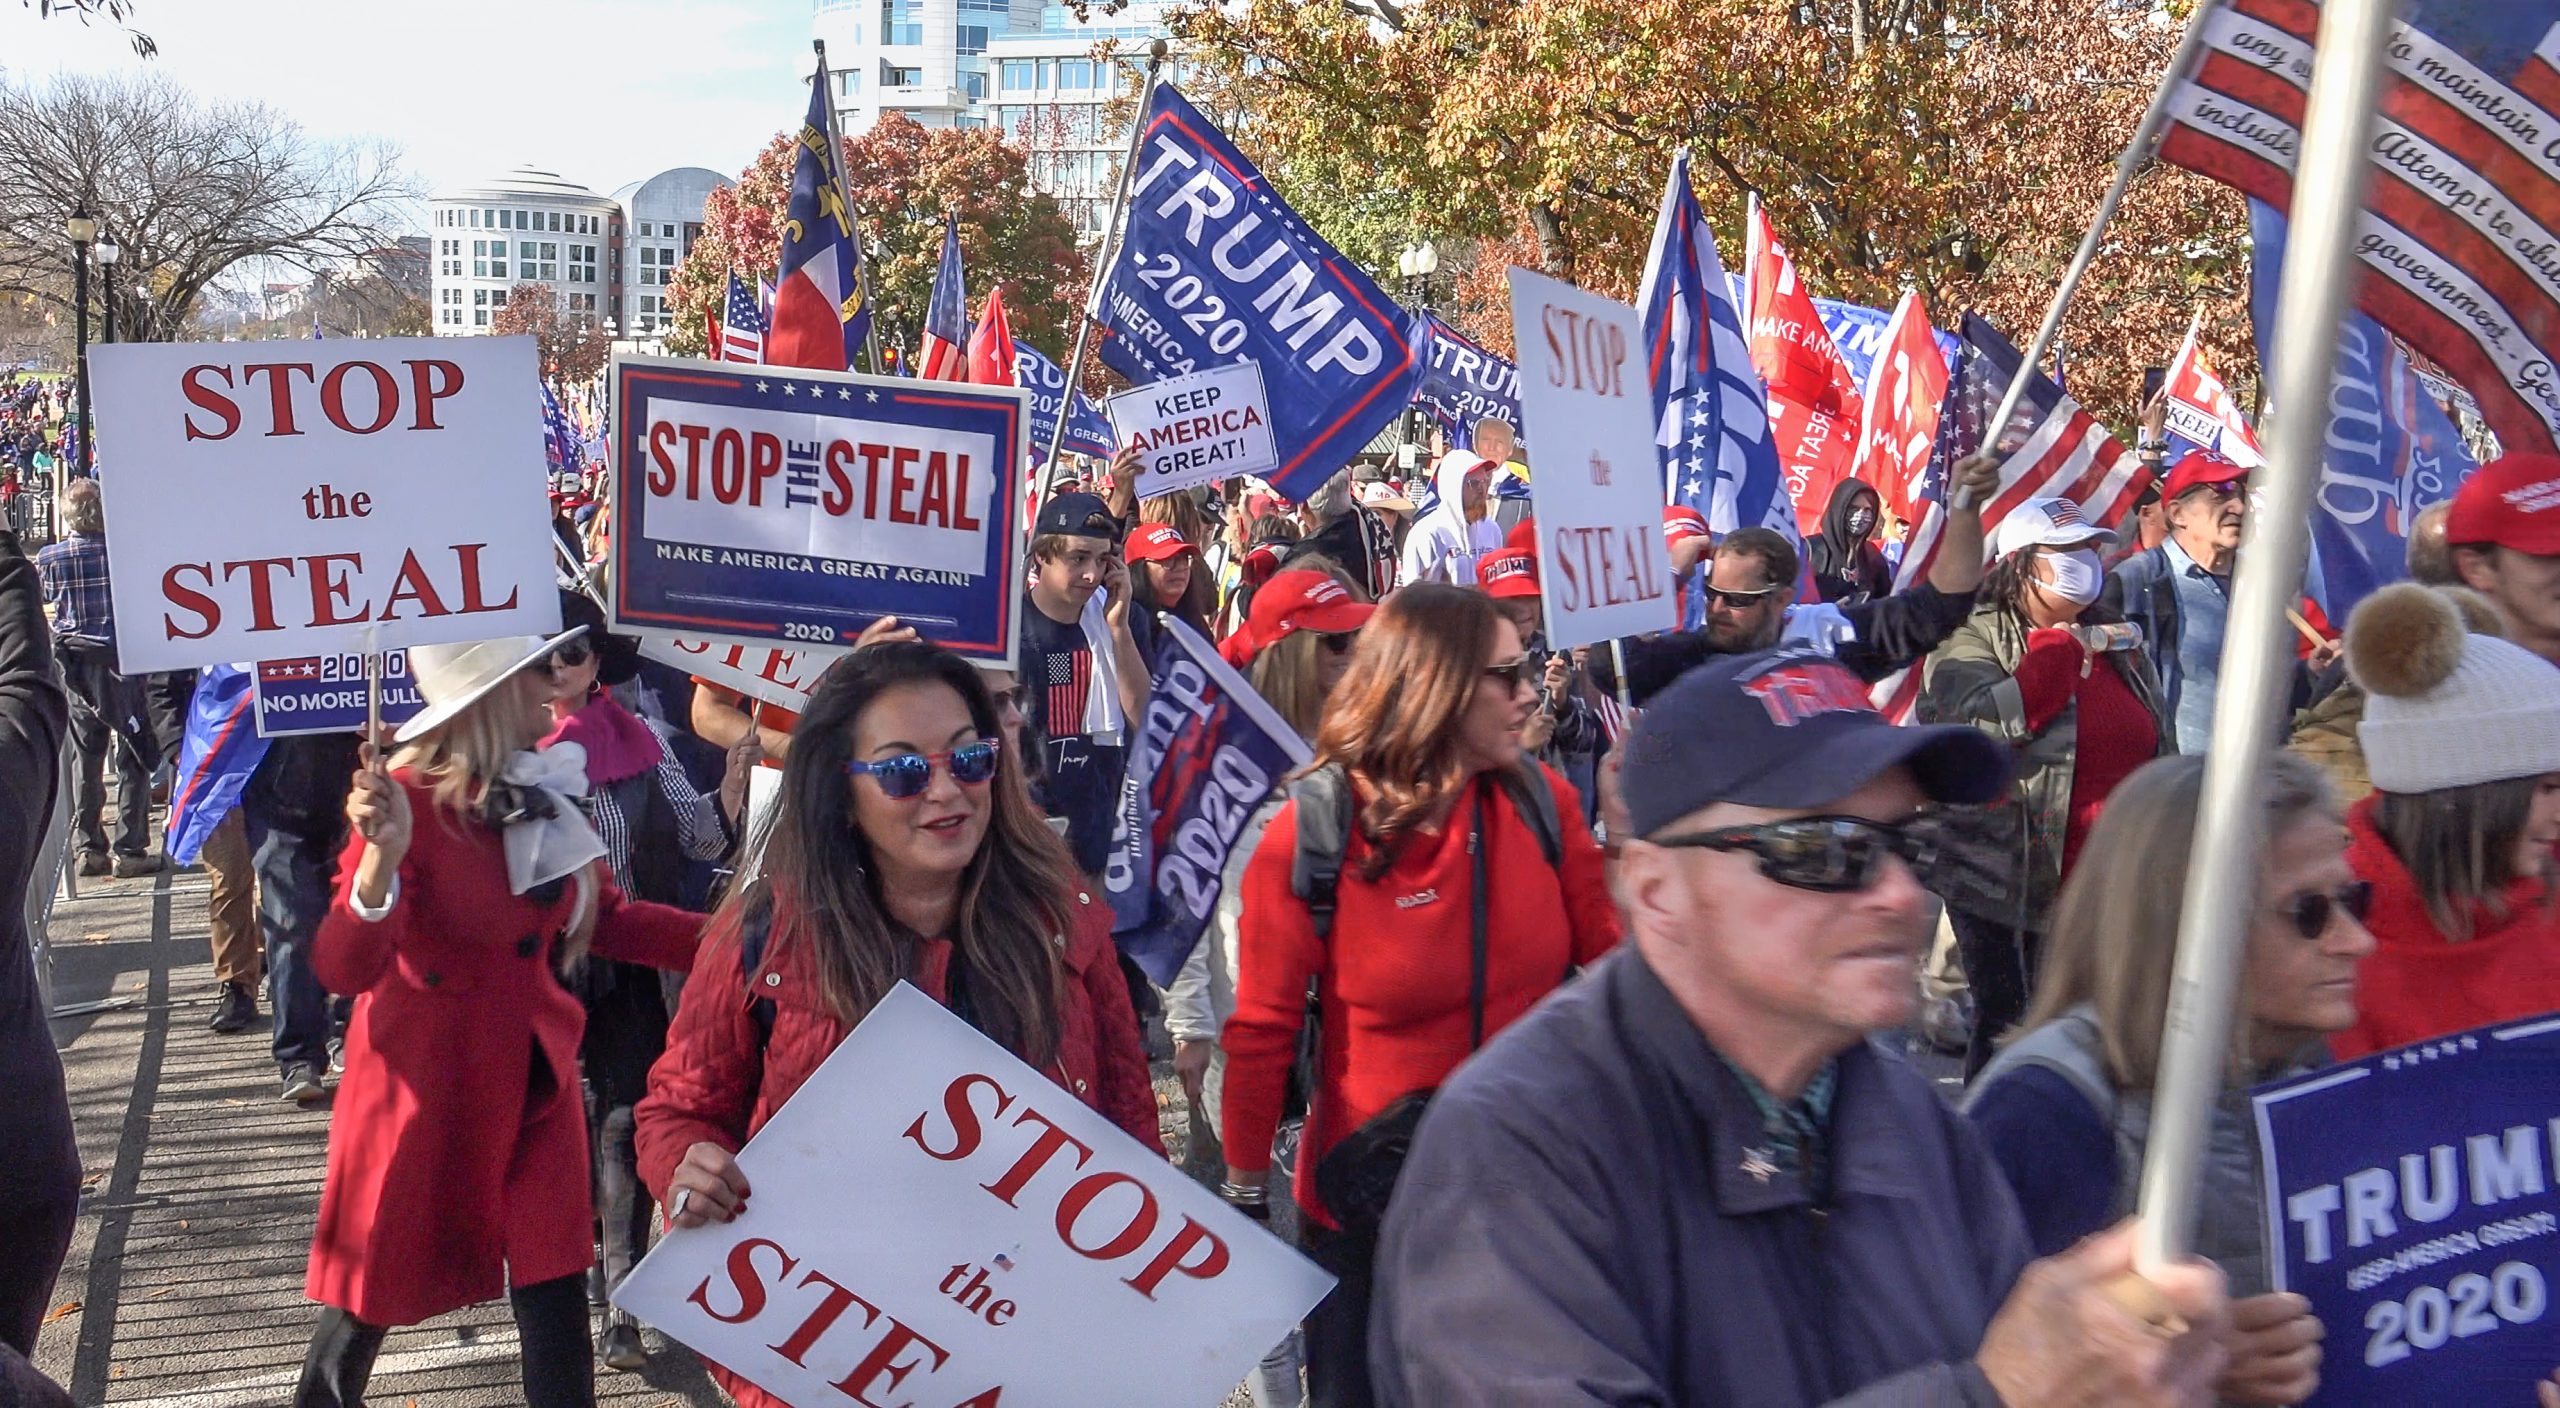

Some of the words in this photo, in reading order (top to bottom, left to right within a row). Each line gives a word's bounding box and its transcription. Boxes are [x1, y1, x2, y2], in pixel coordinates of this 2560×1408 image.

[2232, 32, 2288, 68] any
[2415, 57, 2540, 145] maintain
[2371, 131, 2493, 216] Attempt
[2488, 209, 2514, 239] to
[1132, 133, 1384, 376] TRUMP
[1542, 303, 1627, 396] STOP
[1753, 317, 1802, 343] MAKE
[181, 360, 465, 441] STOP
[1131, 405, 1262, 454] AMERICA
[1155, 386, 1221, 418] KEEP
[648, 420, 782, 507] STOP
[786, 439, 821, 509] THE
[822, 439, 981, 532] STEAL
[1155, 437, 1245, 475] GREAT!
[1589, 448, 1613, 487] the
[302, 484, 372, 520] the
[162, 543, 518, 640] STEAL
[656, 544, 714, 564] MAKE
[719, 551, 815, 574] AMERICA
[820, 560, 890, 581] GREAT
[894, 567, 970, 587] AGAIN!
[1555, 525, 1664, 613] STEAL
[784, 622, 835, 642] 2020
[263, 694, 298, 713] NO
[301, 690, 367, 711] MORE
[379, 687, 423, 705] ULL
[1158, 745, 1269, 920] 2020
[902, 1073, 1231, 1303] STOP
[937, 1260, 1018, 1328] the
[2363, 1260, 2547, 1368] 2020
